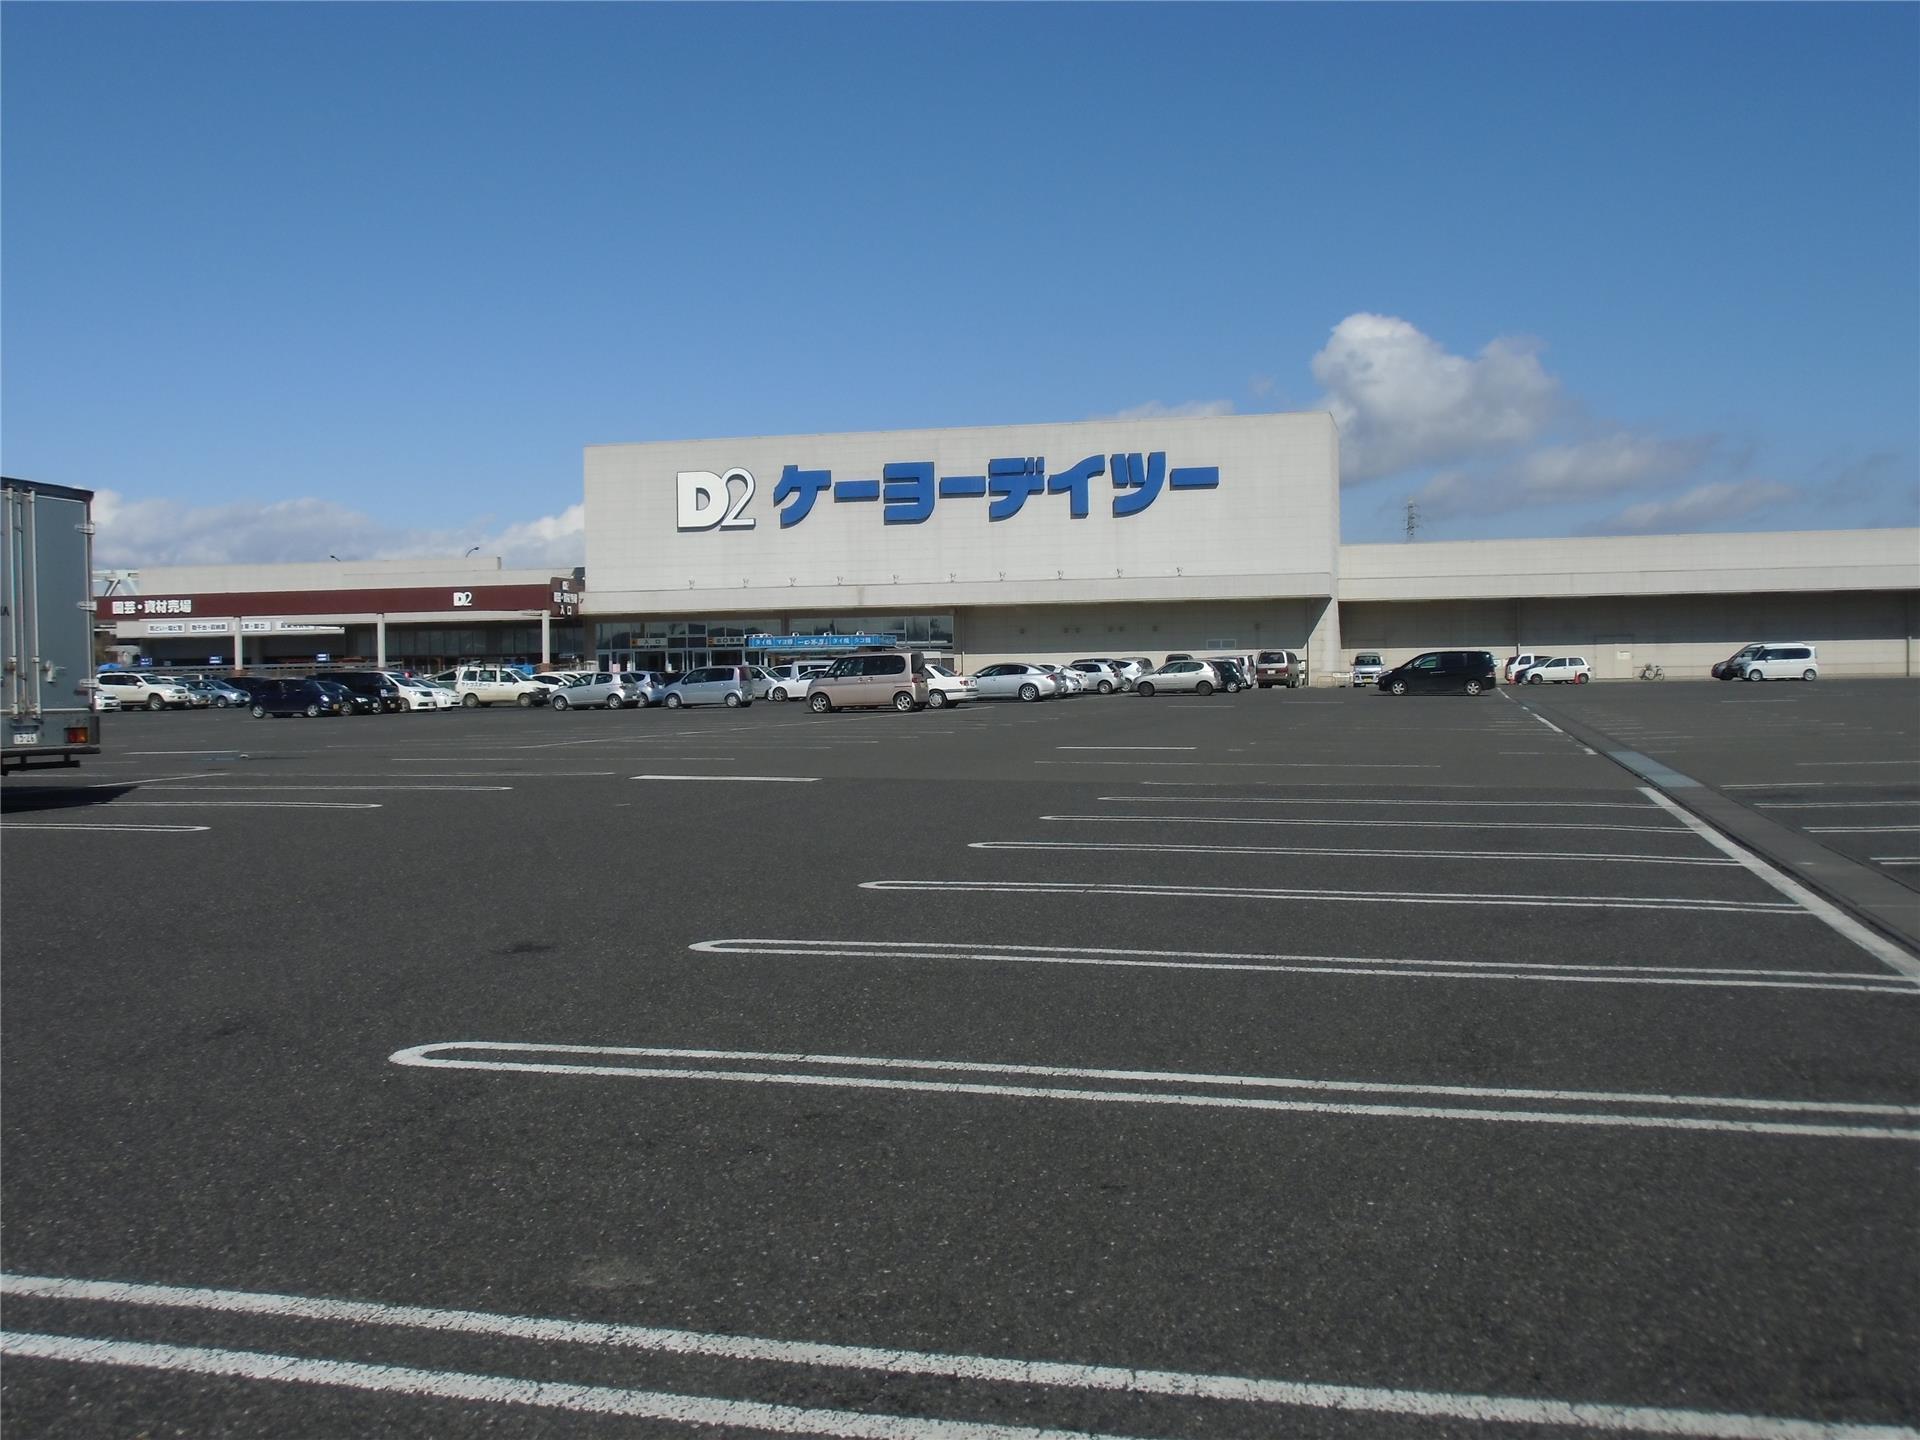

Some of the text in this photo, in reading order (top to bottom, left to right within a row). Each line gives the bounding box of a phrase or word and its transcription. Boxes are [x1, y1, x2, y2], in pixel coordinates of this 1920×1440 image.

[677, 451, 1219, 531] D2 ケーヨーデイツー
[453, 592, 473, 607] D2
[560, 605, 572, 615] 入口
